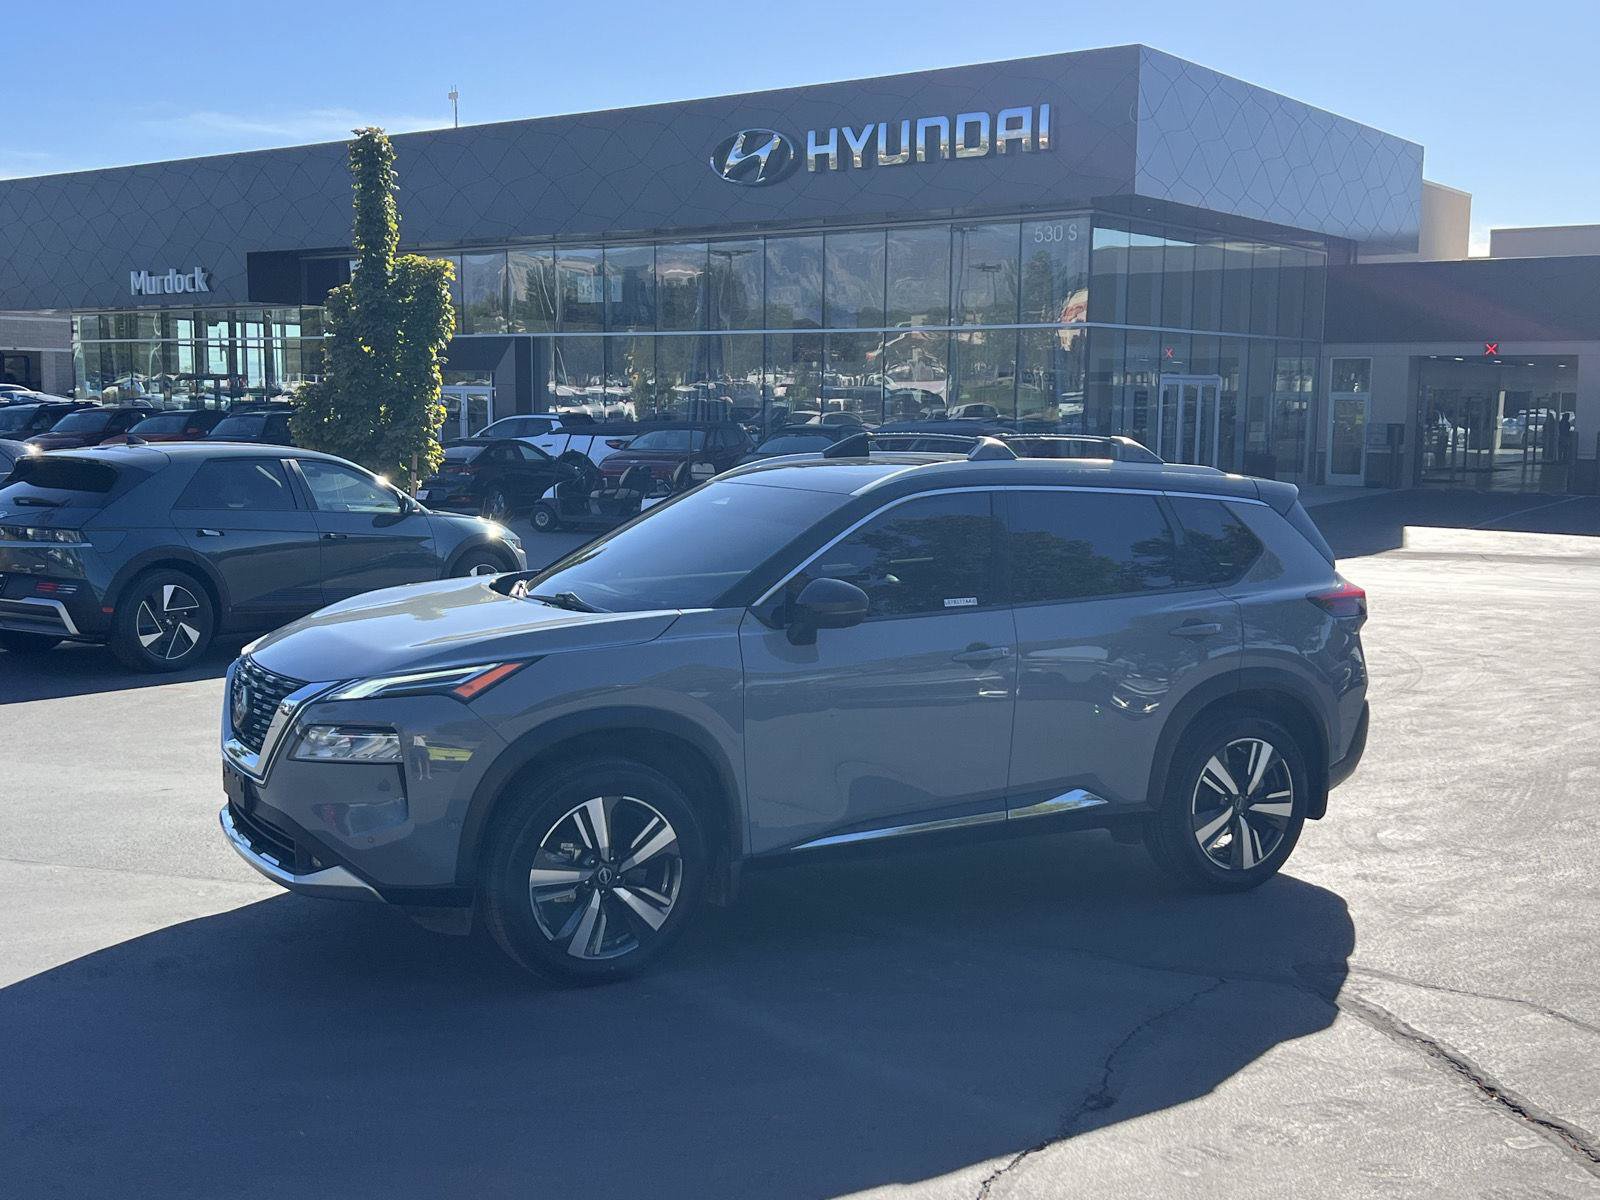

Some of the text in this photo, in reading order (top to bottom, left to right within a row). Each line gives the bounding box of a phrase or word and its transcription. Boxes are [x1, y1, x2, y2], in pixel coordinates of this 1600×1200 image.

[807, 103, 1050, 172] HYUNDAI
[1034, 223, 1078, 243] 530 S
[130, 266, 210, 296] Murdock
